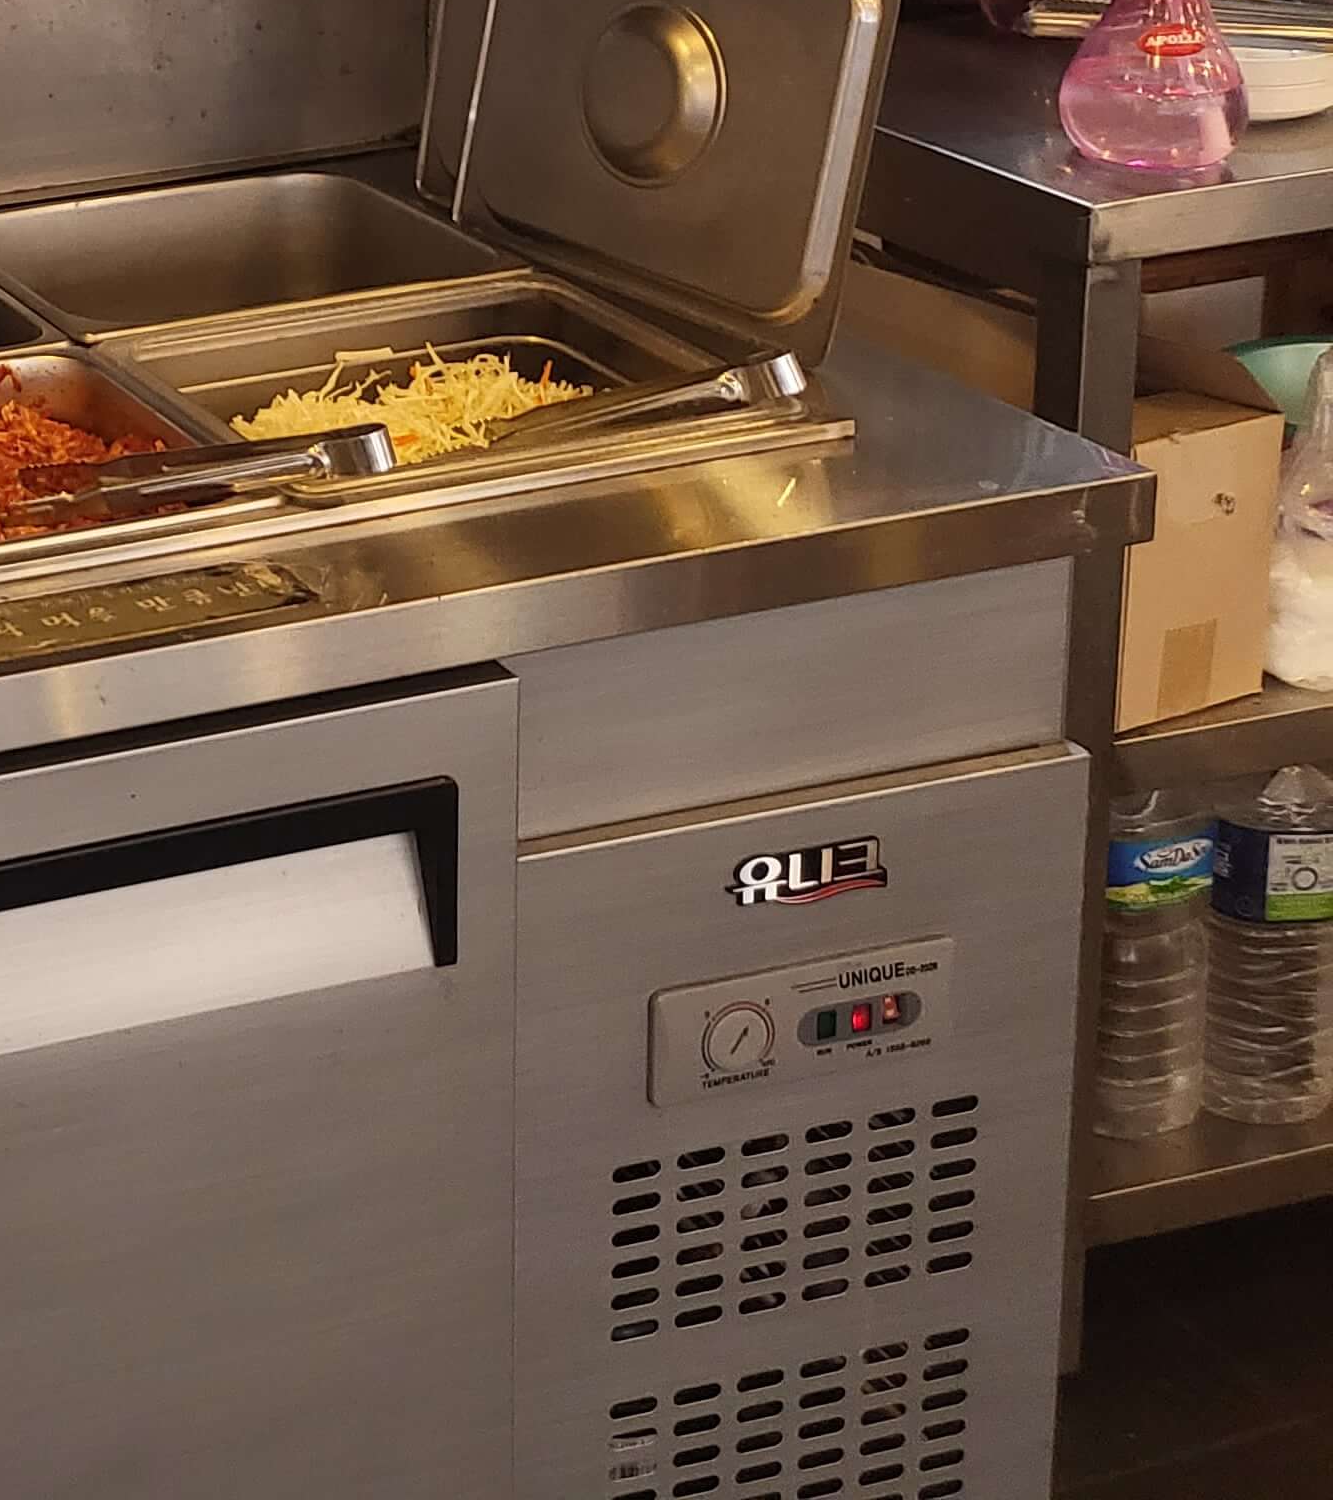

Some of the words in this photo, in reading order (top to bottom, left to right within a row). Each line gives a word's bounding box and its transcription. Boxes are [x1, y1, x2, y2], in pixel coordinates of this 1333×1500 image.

[732, 838, 881, 906] 유니크
[838, 961, 906, 990] UNIQUE
[701, 1067, 771, 1090] TEMPERATURE
